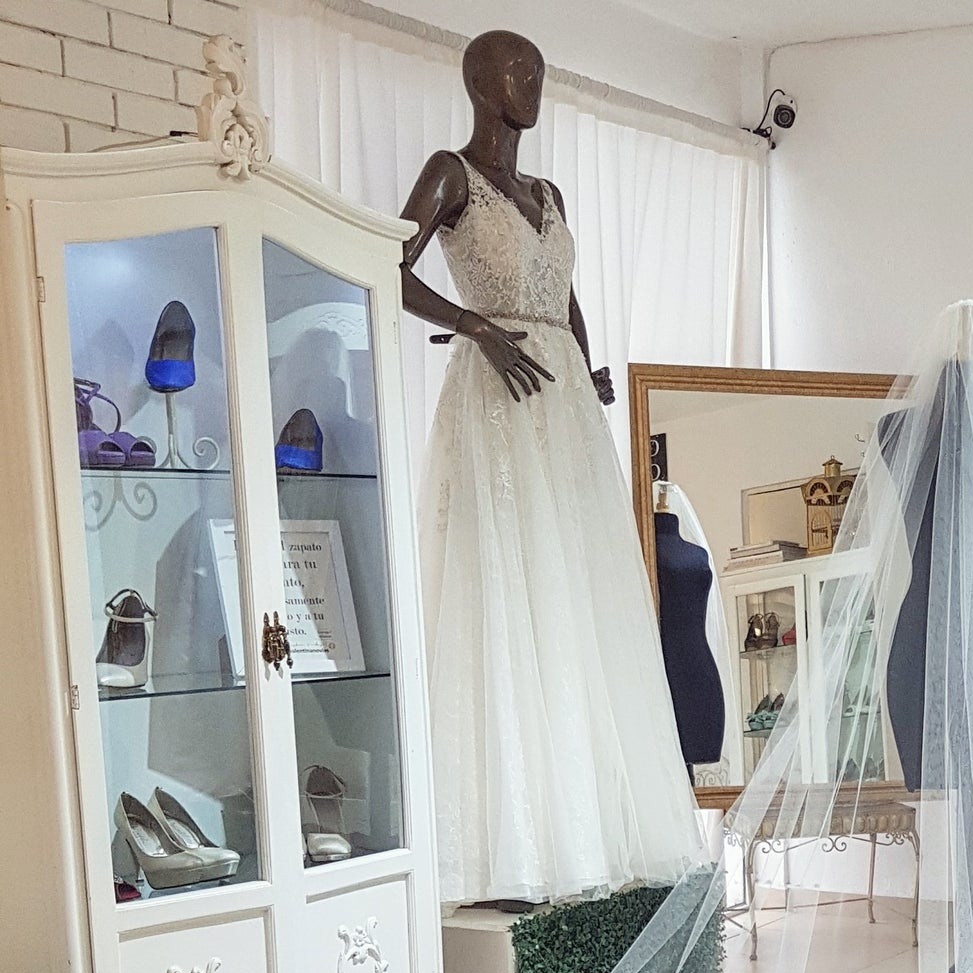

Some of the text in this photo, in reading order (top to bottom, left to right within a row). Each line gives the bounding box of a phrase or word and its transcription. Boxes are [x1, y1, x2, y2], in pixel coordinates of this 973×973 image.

[289, 543, 322, 553] zapato
[304, 560, 318, 569] tu
[313, 612, 325, 620] tu
